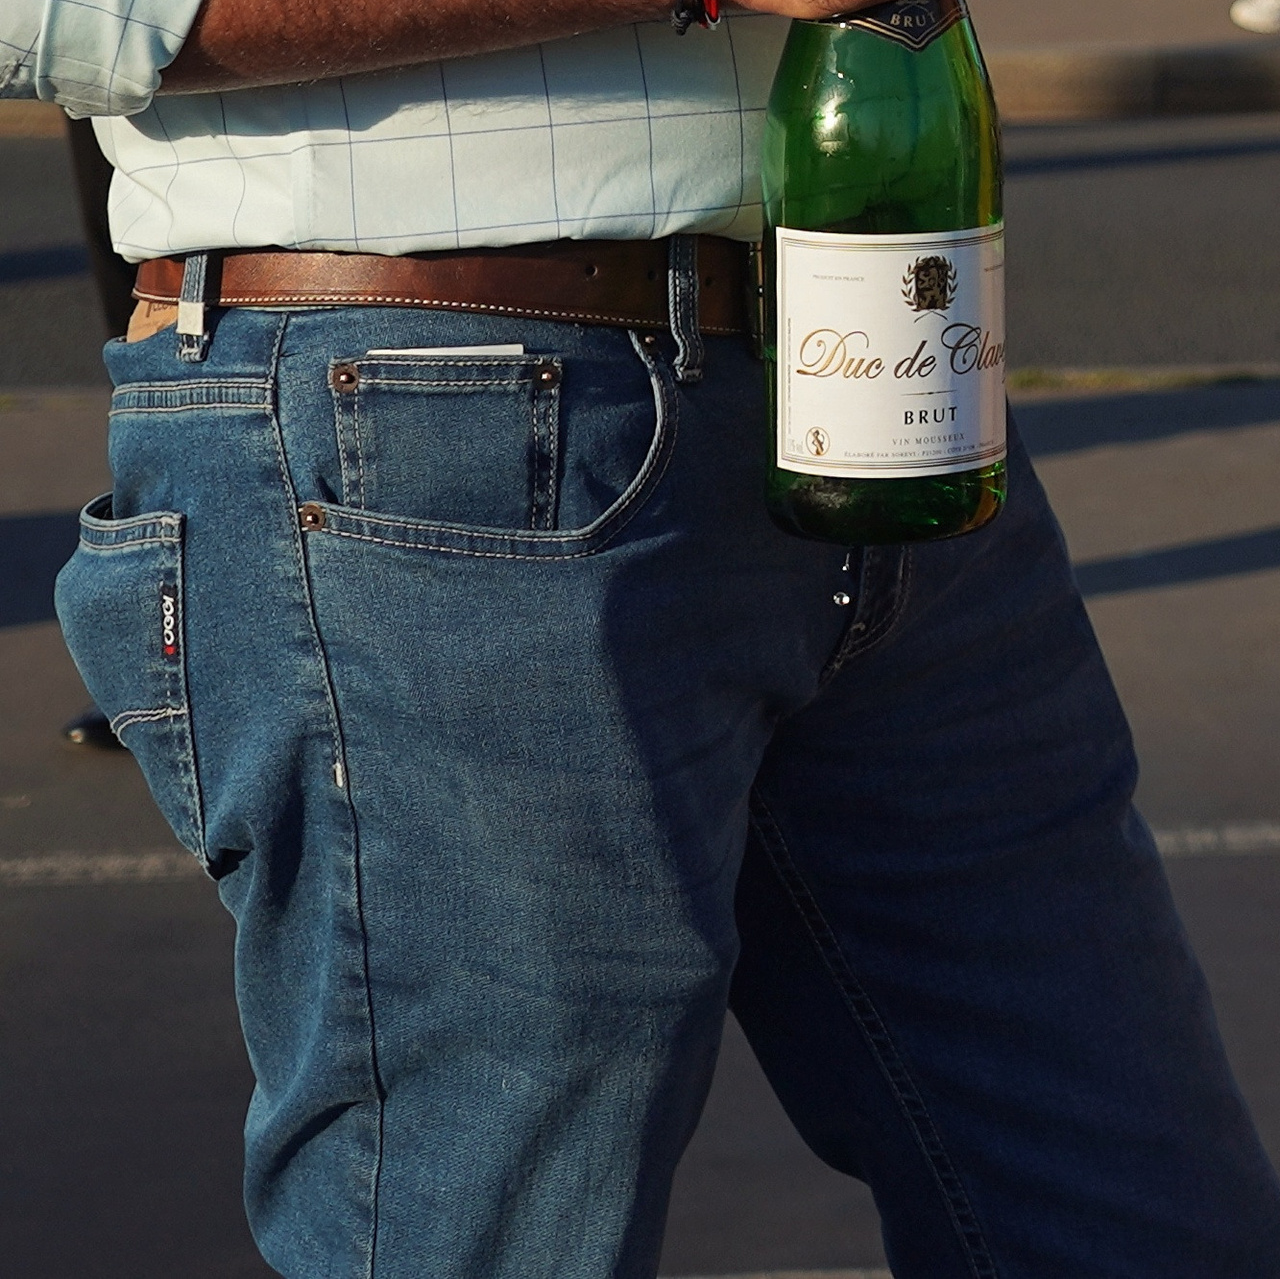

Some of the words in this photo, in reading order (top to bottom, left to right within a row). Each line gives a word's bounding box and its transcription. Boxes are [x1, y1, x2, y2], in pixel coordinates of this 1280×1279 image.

[890, 12, 937, 28] BRUT
[796, 328, 885, 380] Duc
[894, 340, 937, 379] de
[904, 406, 958, 425] BRUT
[892, 438, 911, 446] VIN
[915, 432, 965, 445] MOUSSEUX
